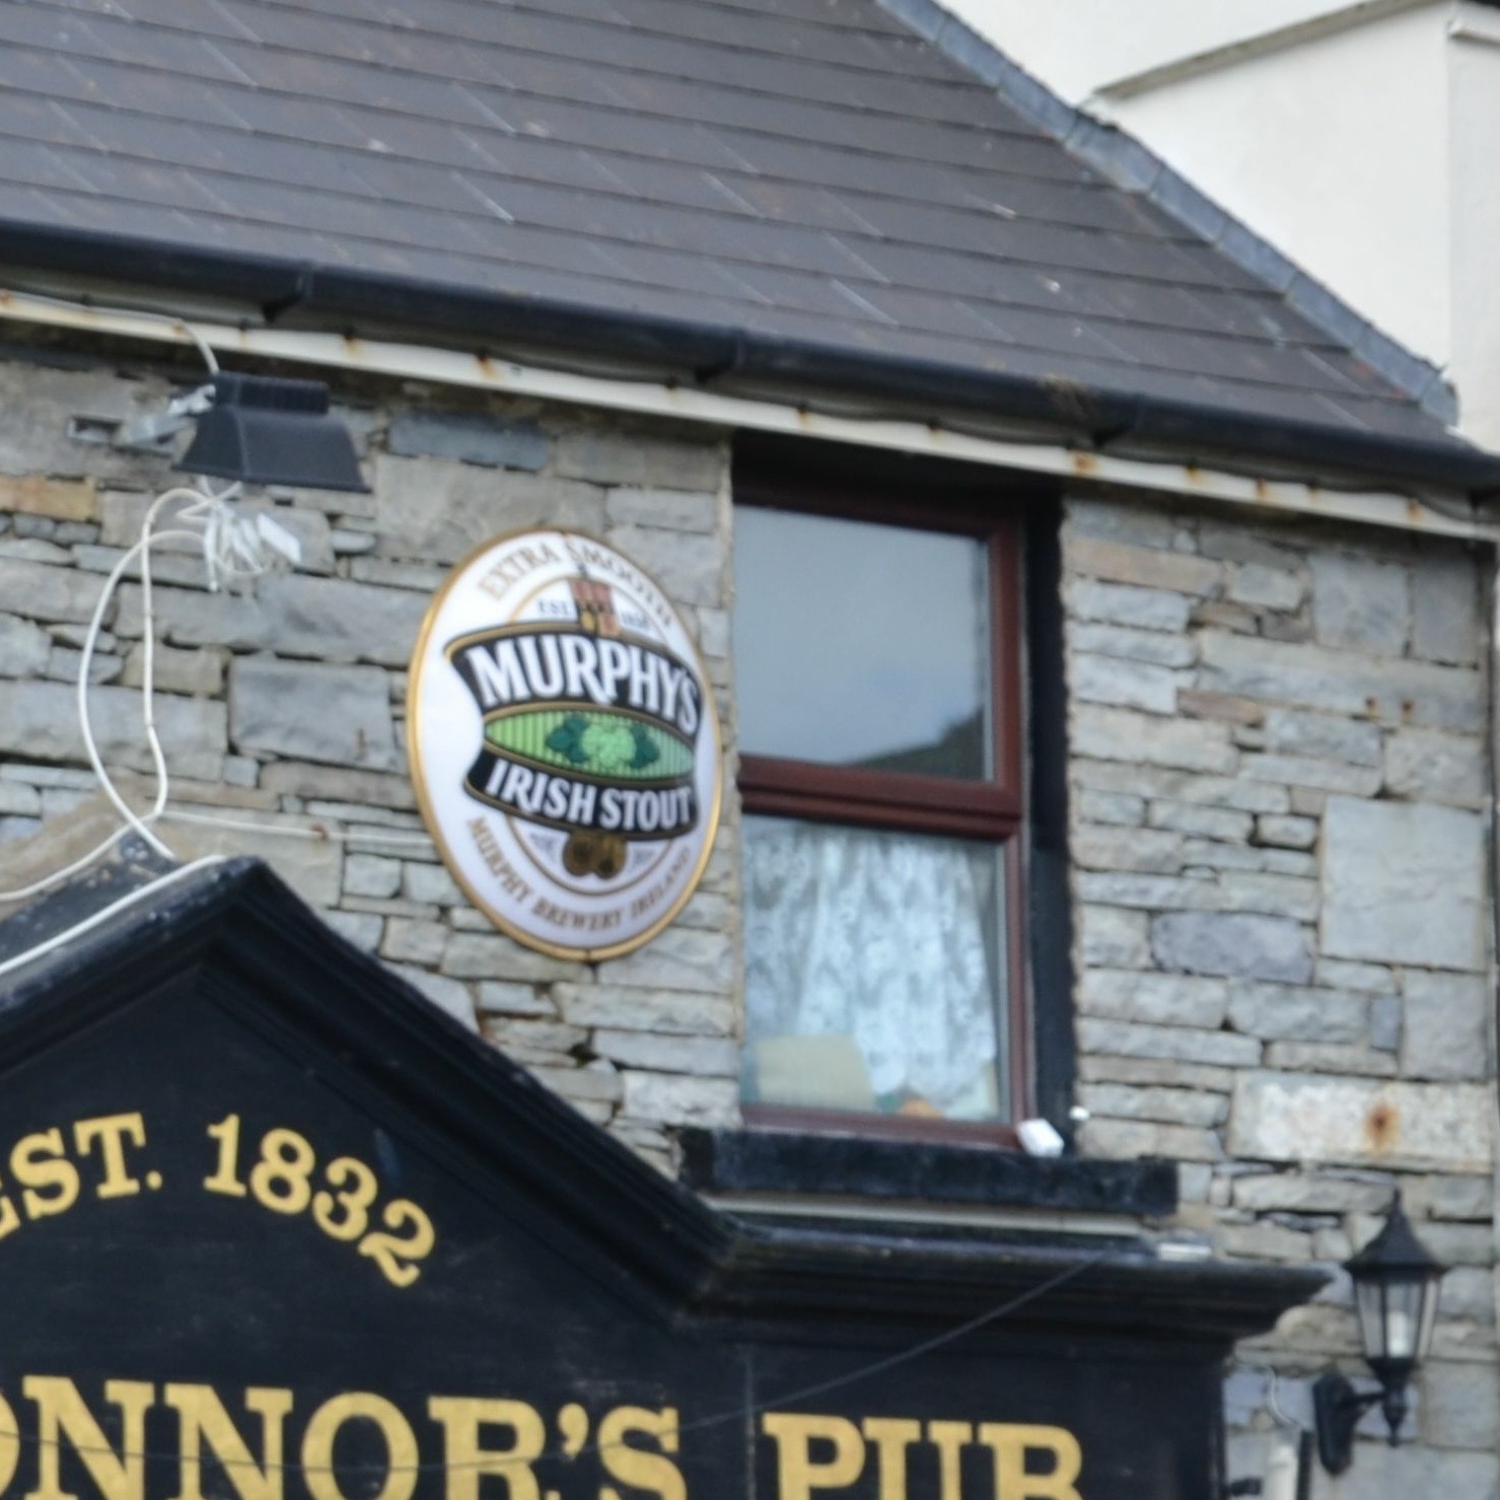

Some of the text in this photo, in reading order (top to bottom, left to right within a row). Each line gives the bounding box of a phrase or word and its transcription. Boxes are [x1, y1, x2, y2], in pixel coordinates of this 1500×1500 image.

[478, 542, 560, 600] EXTRA
[485, 757, 693, 832] IRISH STOUT
[466, 814, 535, 904] MURPHY
[531, 897, 625, 931] BREWERY
[203, 1113, 436, 1288] 1832
